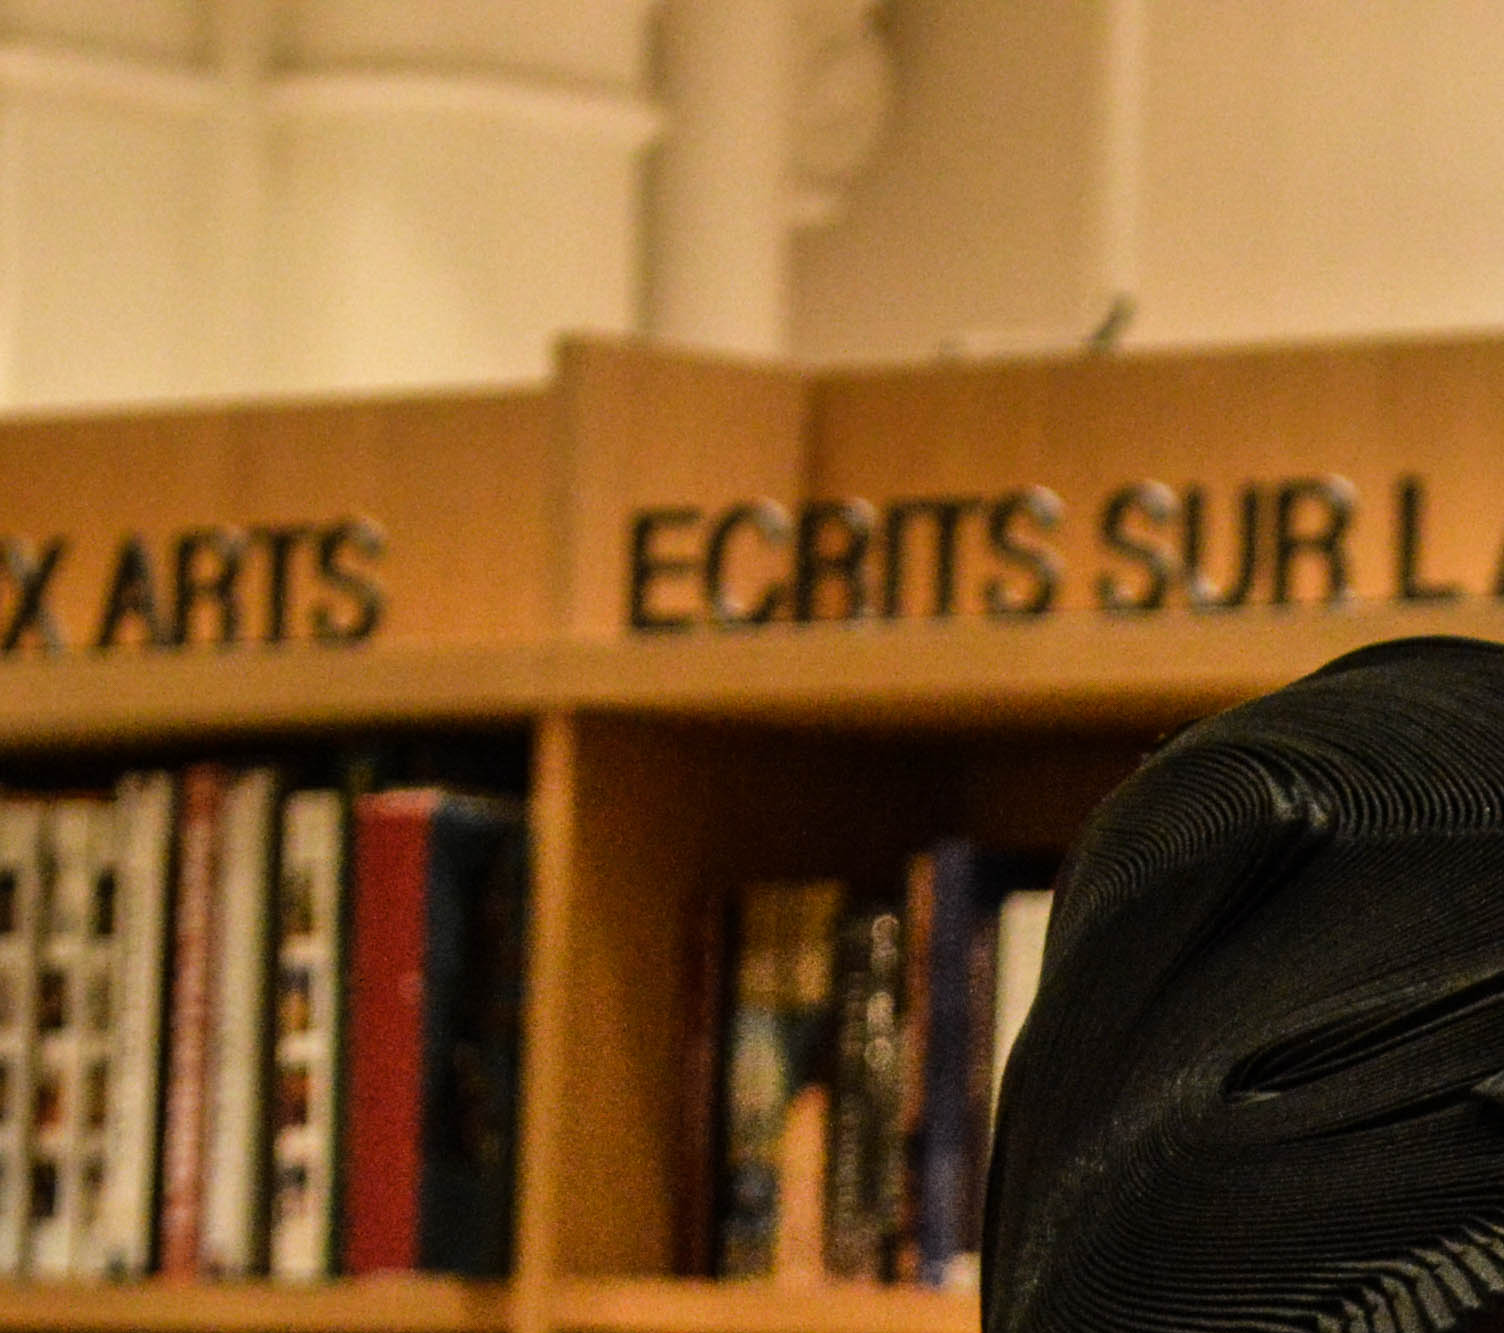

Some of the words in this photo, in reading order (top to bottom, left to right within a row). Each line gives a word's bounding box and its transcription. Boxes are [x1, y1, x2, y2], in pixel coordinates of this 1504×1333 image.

[89, 517, 386, 652] ARTS
[628, 483, 1063, 633] ECRITS
[1096, 475, 1356, 613] SUR
[1393, 472, 1459, 604] L
